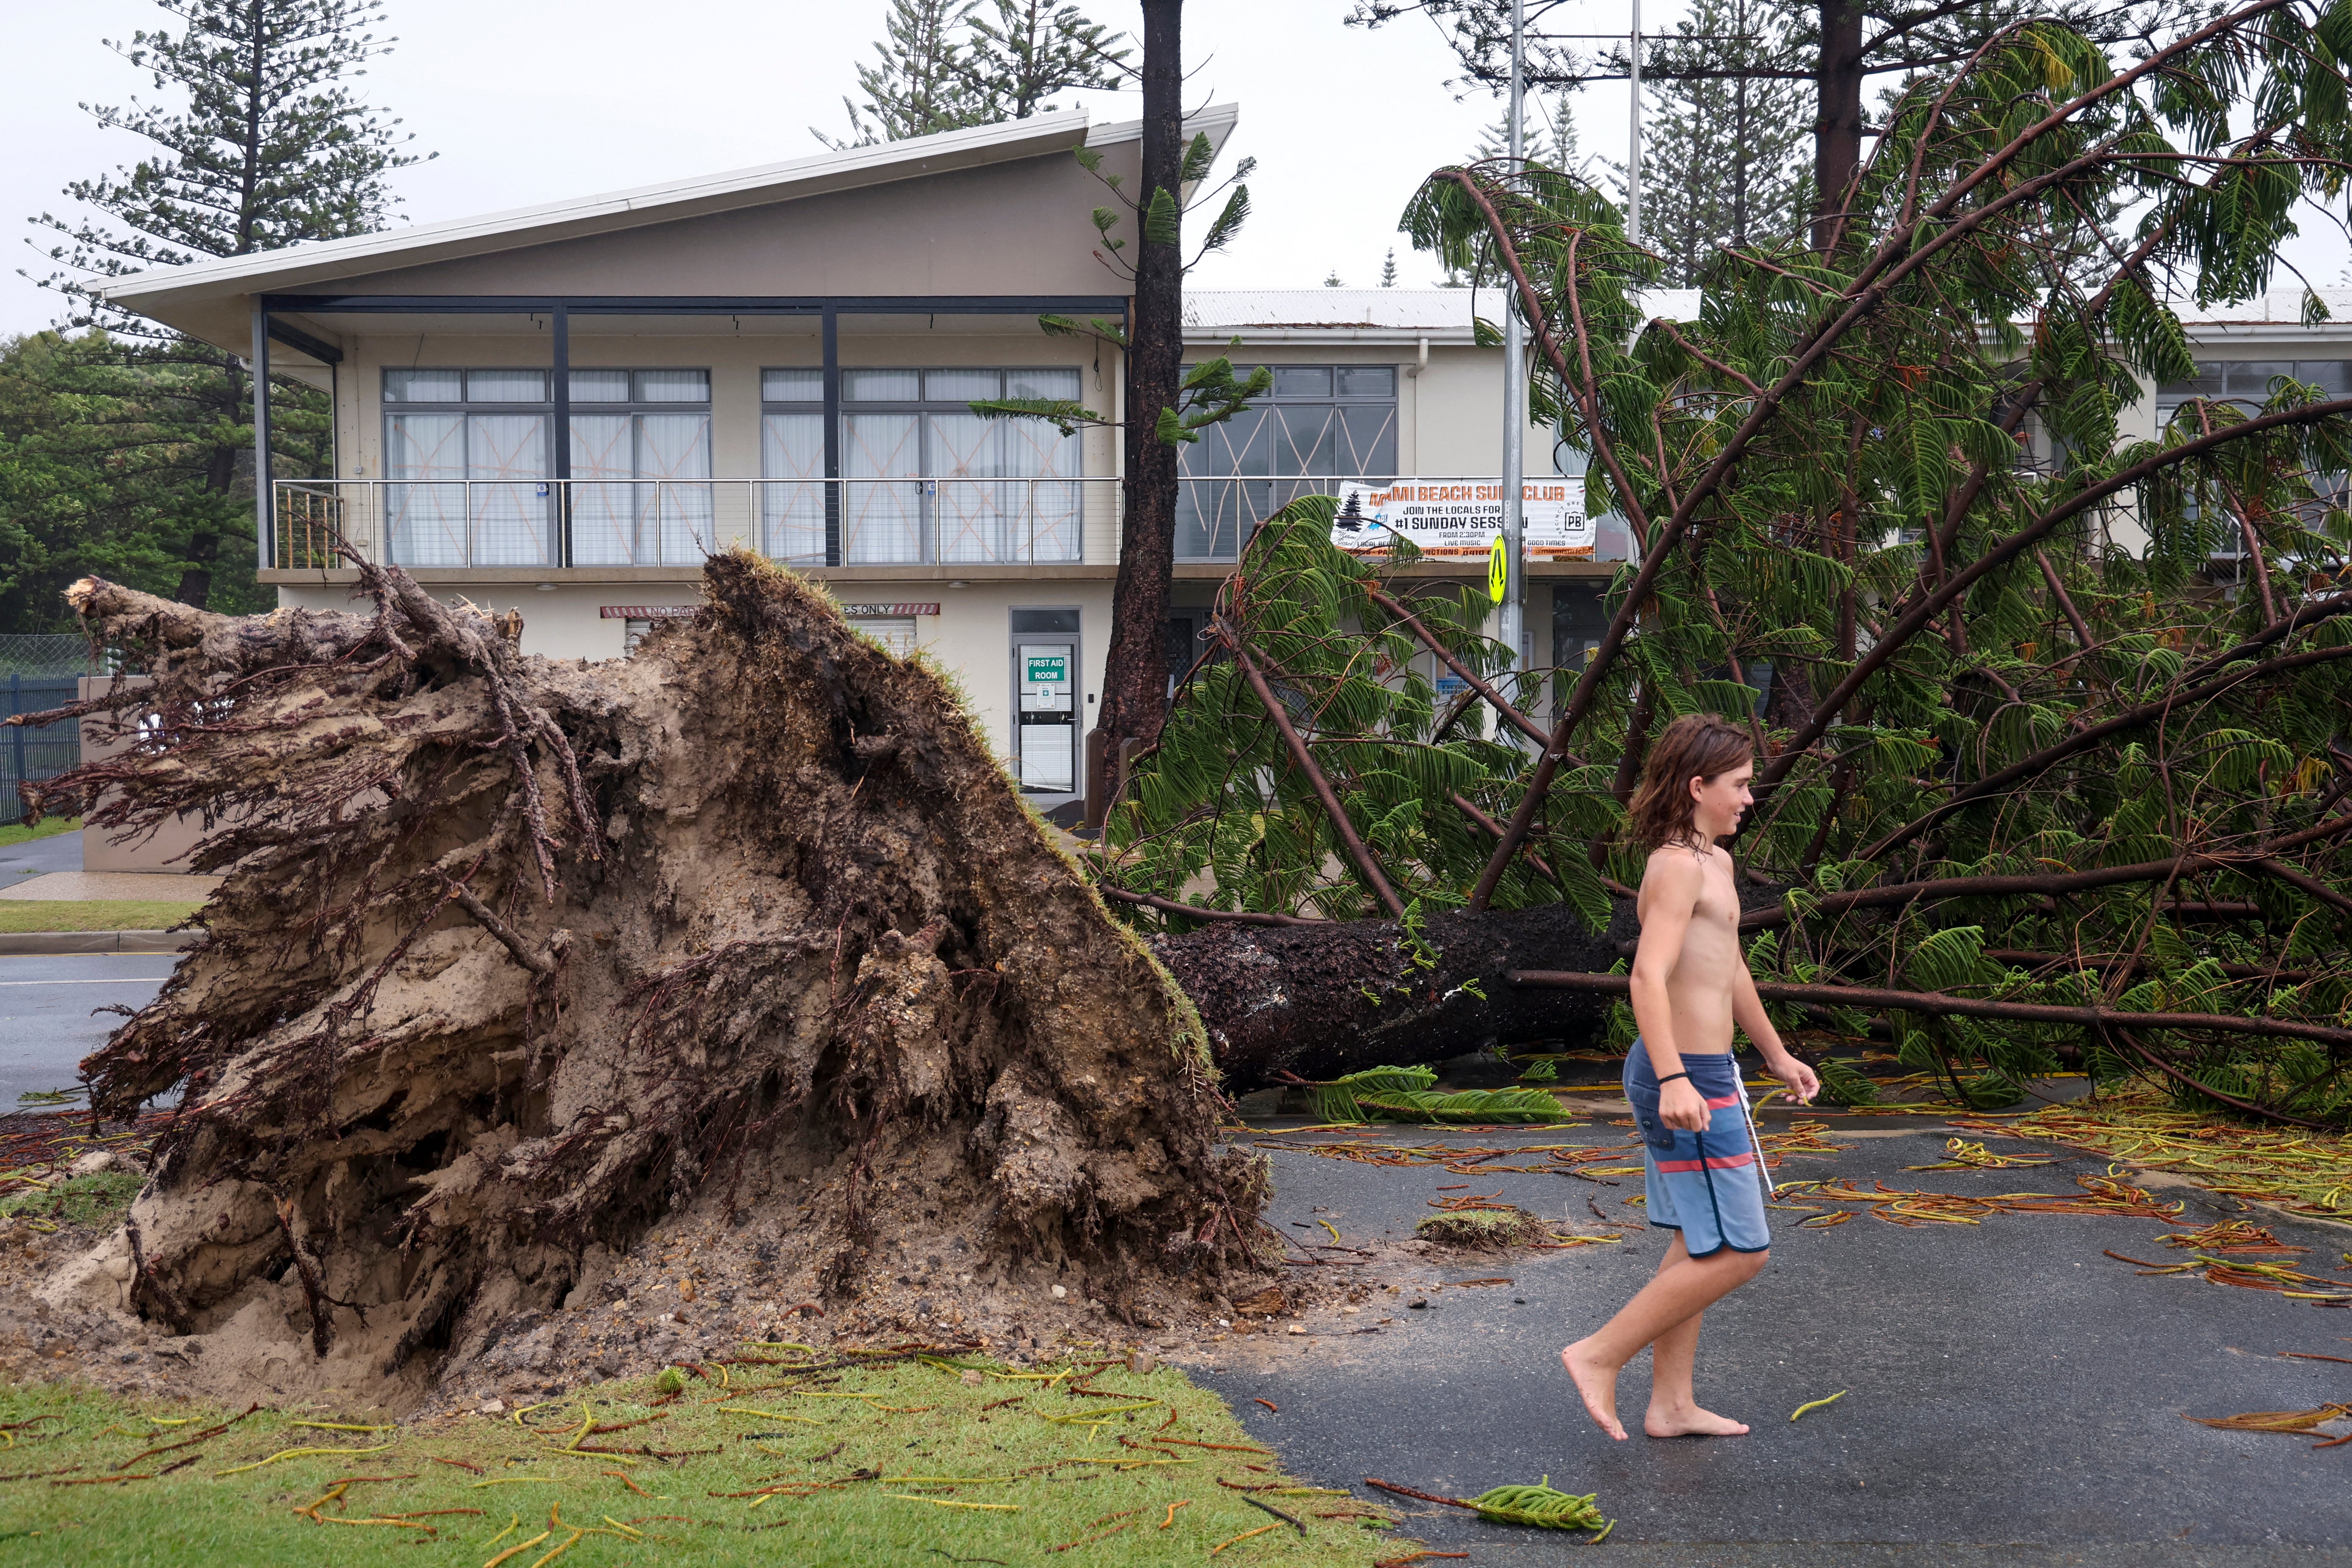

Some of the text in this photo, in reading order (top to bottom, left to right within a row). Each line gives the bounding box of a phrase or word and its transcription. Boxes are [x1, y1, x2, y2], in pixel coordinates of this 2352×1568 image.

[1369, 486, 1565, 507] MAMI BEACH SU CLUB
[1403, 506, 1424, 514] JOIN
[1445, 506, 1481, 514] LOCALS
[1483, 506, 1501, 514] FOR
[1395, 517, 1528, 529] #1 SUNDAY SESSN
[1568, 516, 1581, 527] PB
[650, 607, 667, 617] NO
[861, 605, 890, 614] ONLY
[1029, 659, 1050, 667] FIRST
